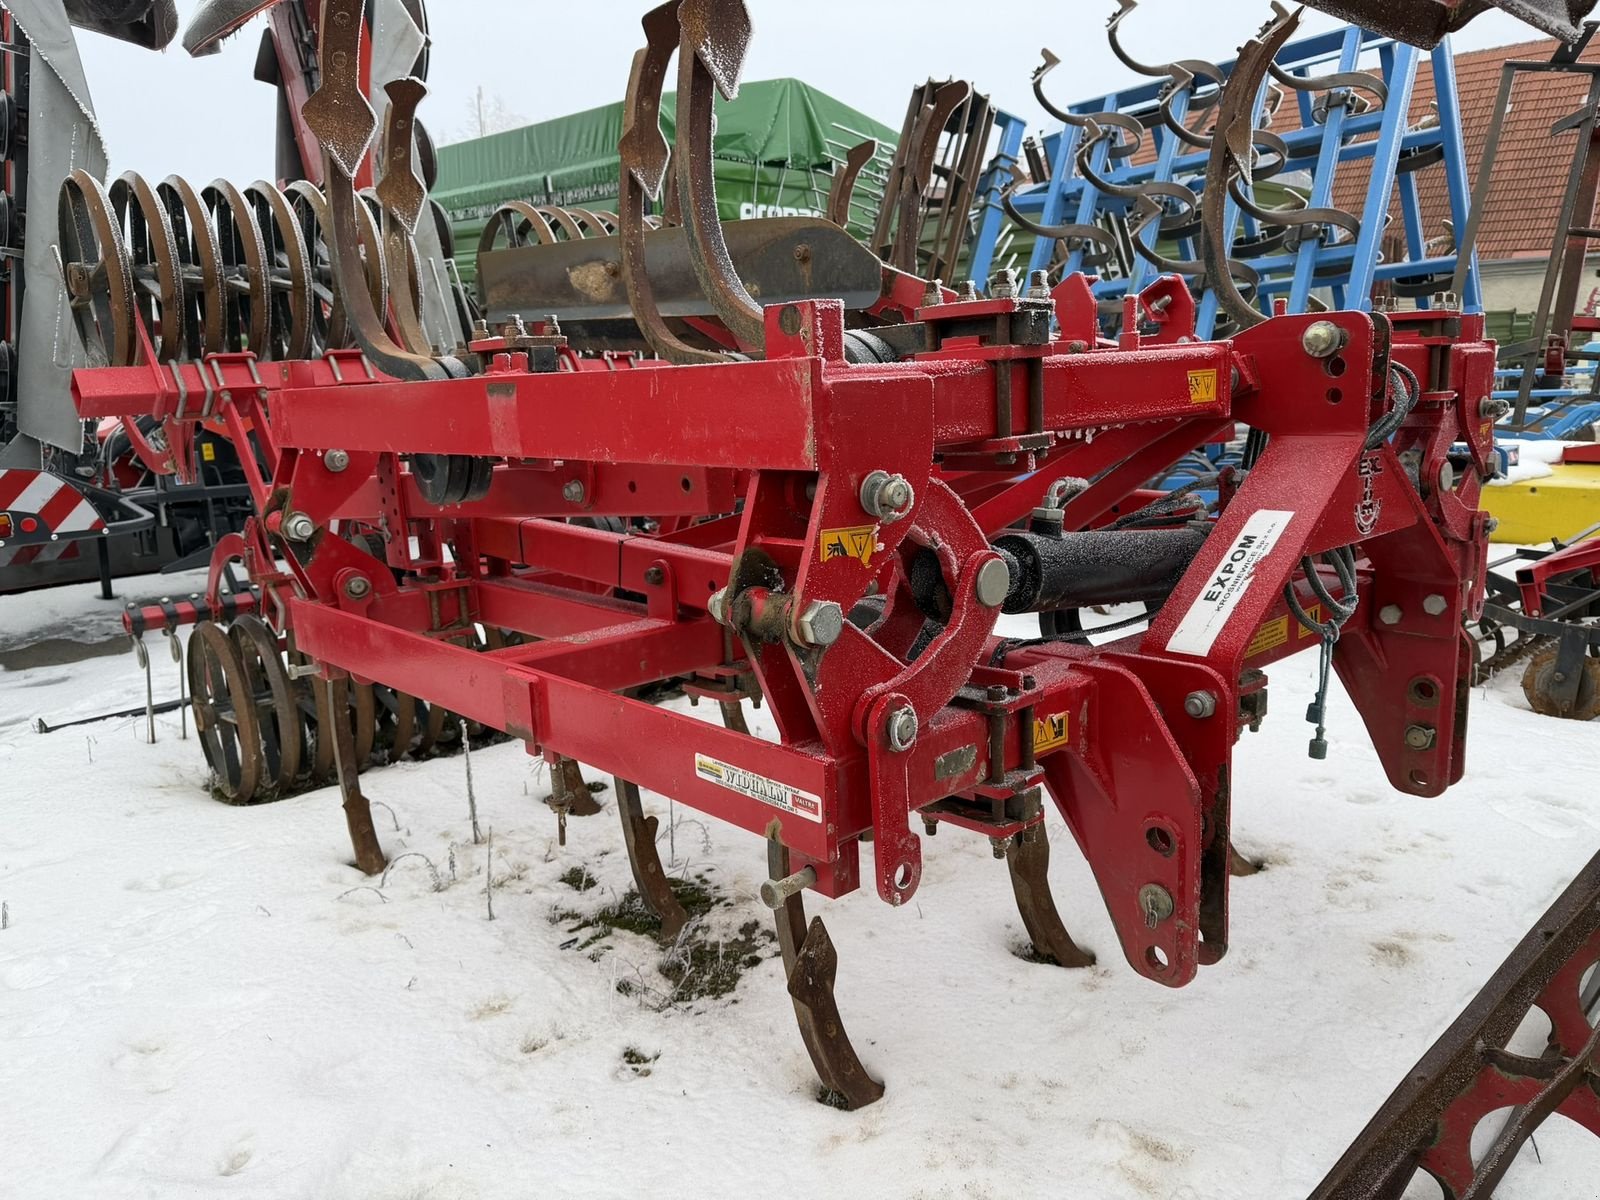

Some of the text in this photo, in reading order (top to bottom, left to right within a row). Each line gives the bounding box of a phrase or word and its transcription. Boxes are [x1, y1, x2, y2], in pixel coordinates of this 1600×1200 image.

[1203, 535, 1257, 601] EXPOM
[724, 769, 788, 804] WIDHALM
[794, 796, 815, 809] VALTRA
